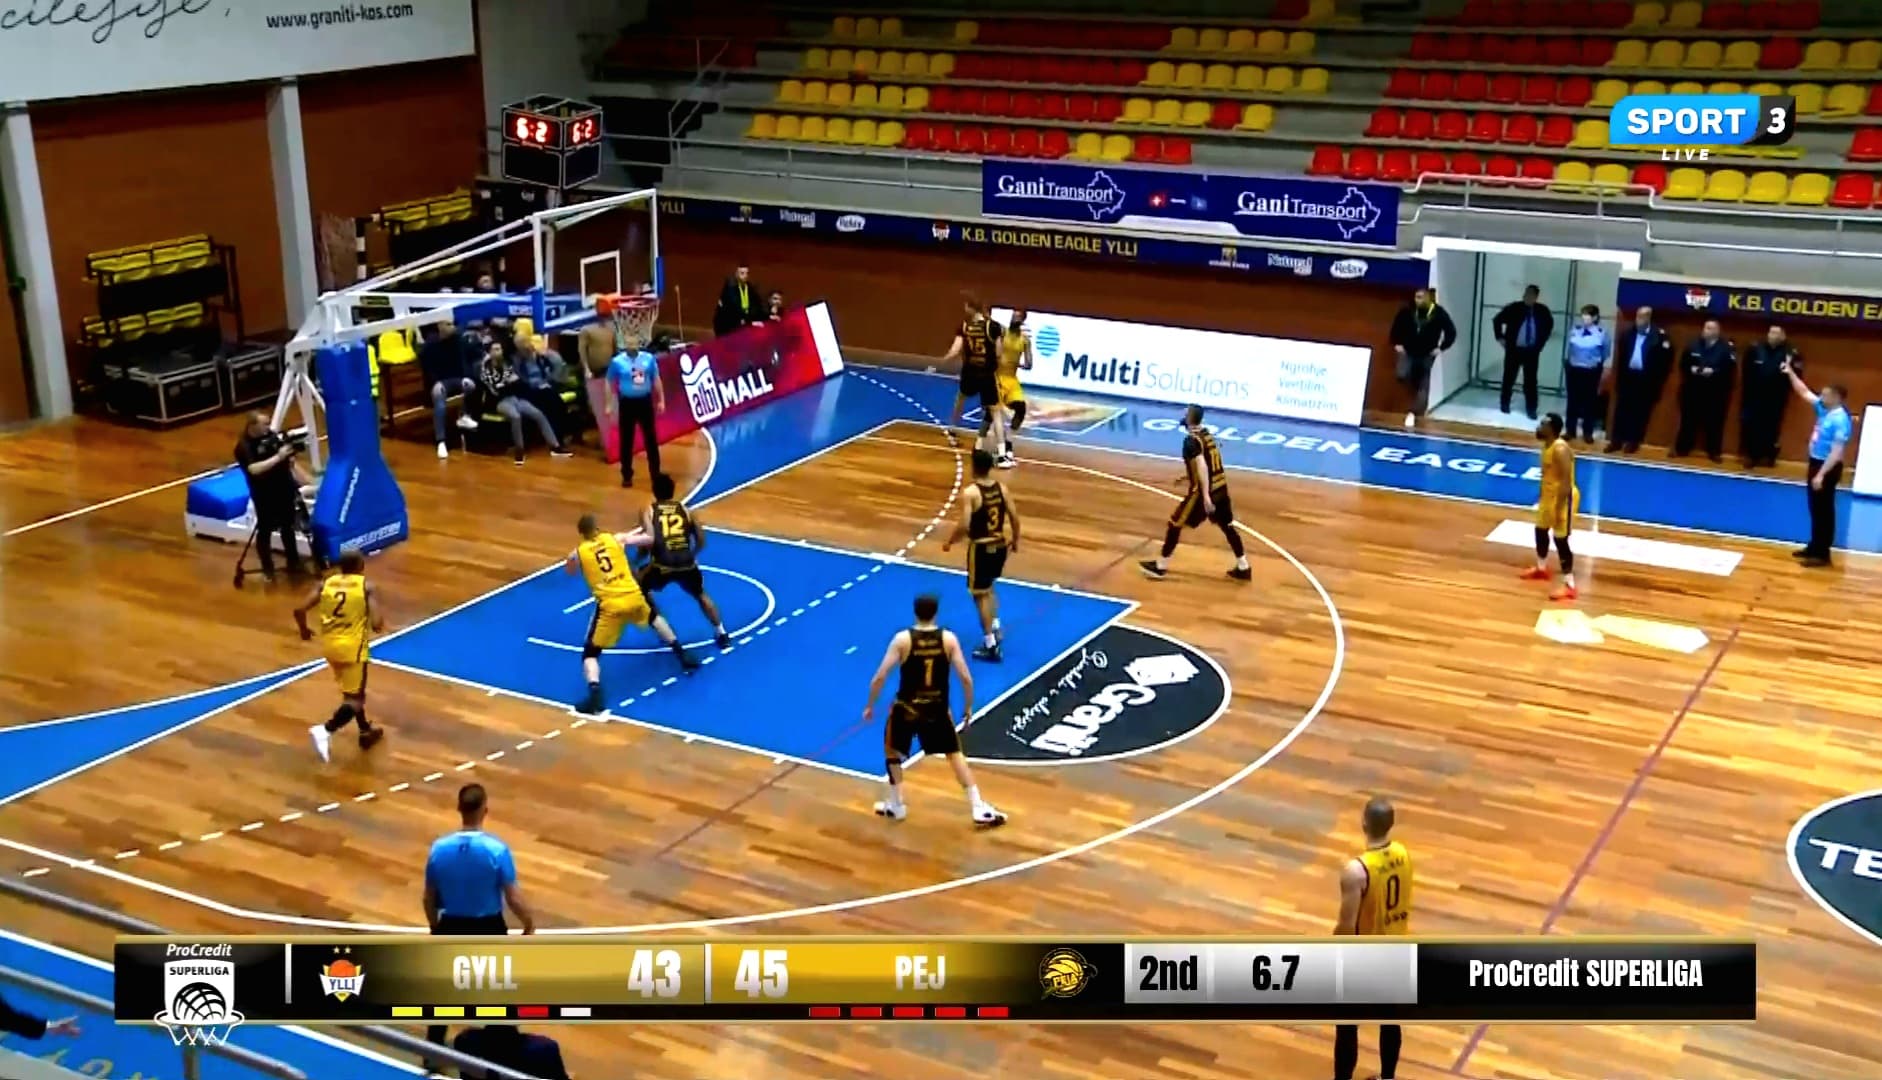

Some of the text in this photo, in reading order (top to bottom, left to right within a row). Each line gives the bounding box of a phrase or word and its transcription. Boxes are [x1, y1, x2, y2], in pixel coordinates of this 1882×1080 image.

[266, 3, 414, 30] www.graniti-kos.com
[998, 174, 1113, 202] Gani Transport
[660, 200, 685, 215] YLLI
[1237, 191, 1366, 219] Gani Transport
[962, 226, 1138, 257] K.B. GOLDEN EAGLE YLLI
[1728, 293, 1765, 312] K.B.
[1771, 296, 1859, 319] GOLDEN
[1062, 352, 1249, 399] Multi Solutions
[692, 368, 774, 418] albi MALL
[658, 513, 685, 538] 12
[987, 506, 999, 531] 3
[594, 548, 613, 573] 5
[333, 591, 346, 618] 2
[923, 658, 934, 687] 1
[1386, 874, 1400, 911] 0
